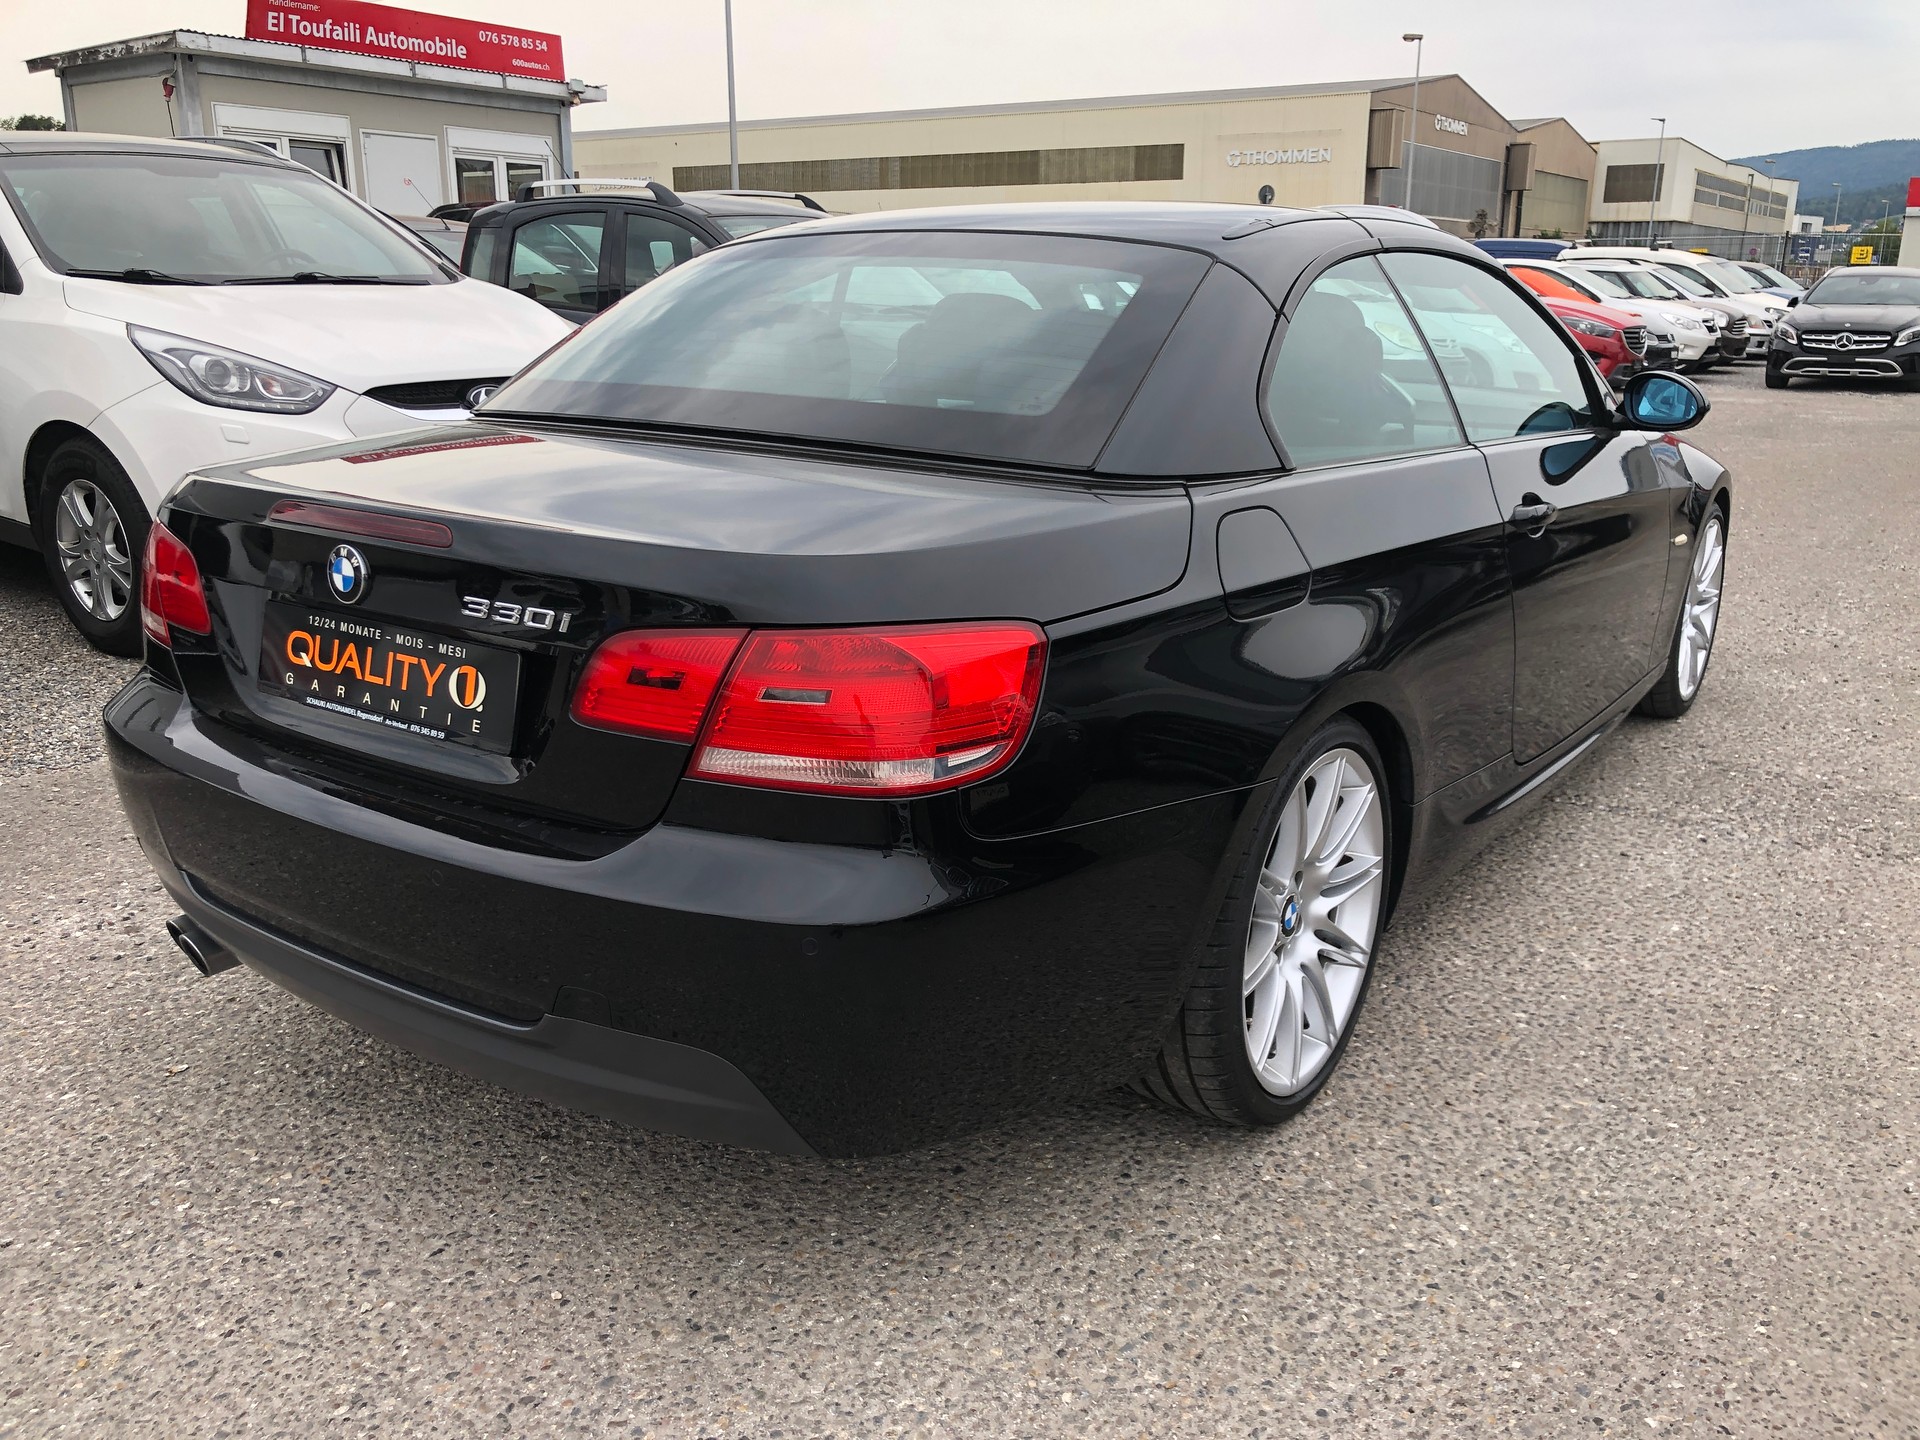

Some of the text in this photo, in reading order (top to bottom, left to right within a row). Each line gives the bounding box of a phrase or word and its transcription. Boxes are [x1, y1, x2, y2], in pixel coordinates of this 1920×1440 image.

[267, 11, 467, 59] El Toufaili Automobile
[479, 30, 548, 52] 076 578 85 54
[512, 58, 551, 71] 600autos.ch
[1243, 148, 1331, 165] THOMMEN
[460, 595, 572, 633] 330i
[308, 615, 336, 630] 12/24
[340, 621, 382, 640] MONATE
[395, 634, 424, 649] MOIS
[438, 643, 467, 659] MESI
[287, 630, 446, 697] QUALITY
[285, 672, 481, 733] GARANTIE
